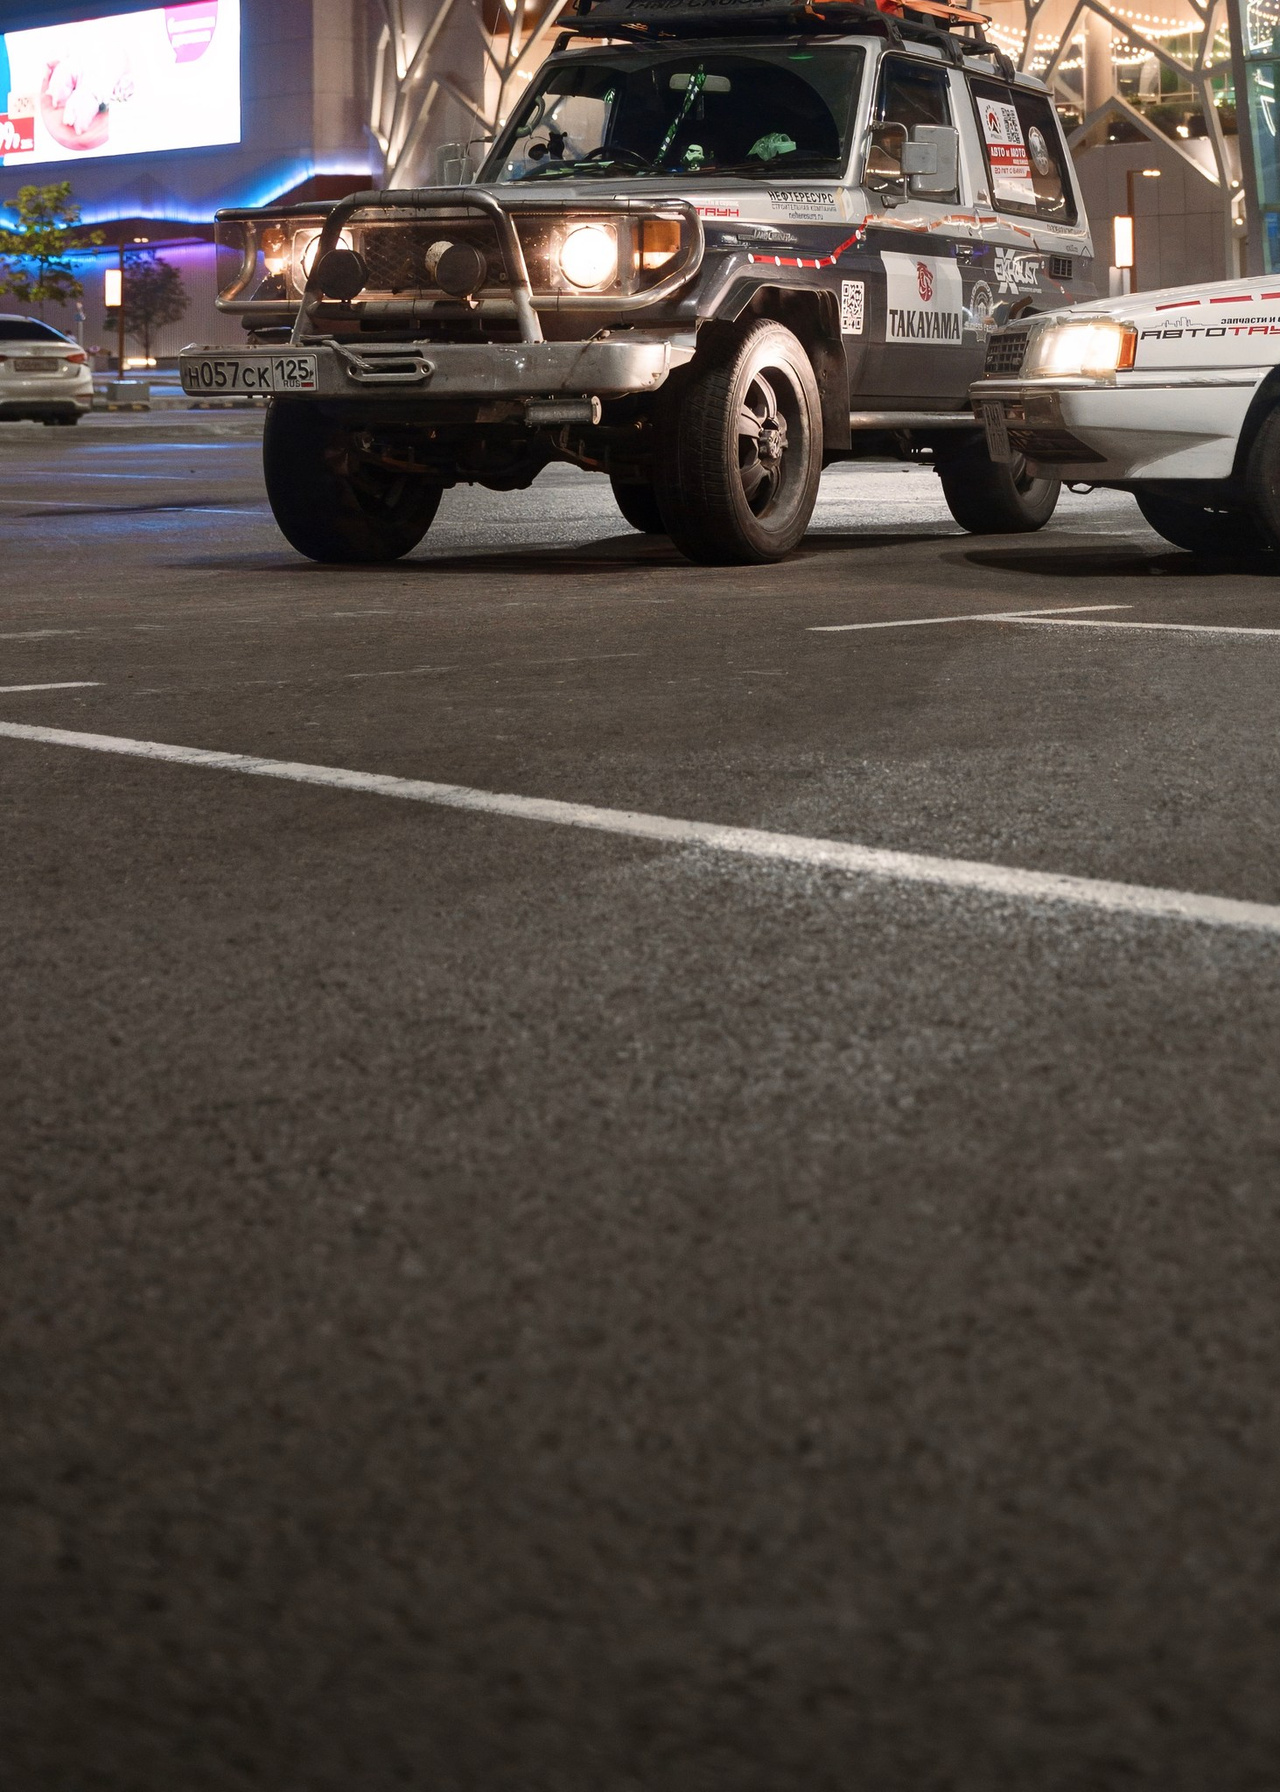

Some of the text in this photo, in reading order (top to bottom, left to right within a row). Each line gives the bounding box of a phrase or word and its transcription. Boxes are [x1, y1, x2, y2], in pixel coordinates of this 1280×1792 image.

[767, 190, 835, 204] НЕФТЕРЕСУРС
[696, 207, 739, 218] ТАУН
[994, 247, 1039, 295] EXHAUST
[889, 309, 961, 340] TAKAYAMA
[1220, 316, 1268, 325] запчасти
[1268, 315, 1276, 324] и
[188, 359, 309, 388] Н057СК 125
[283, 379, 301, 388] RUS
